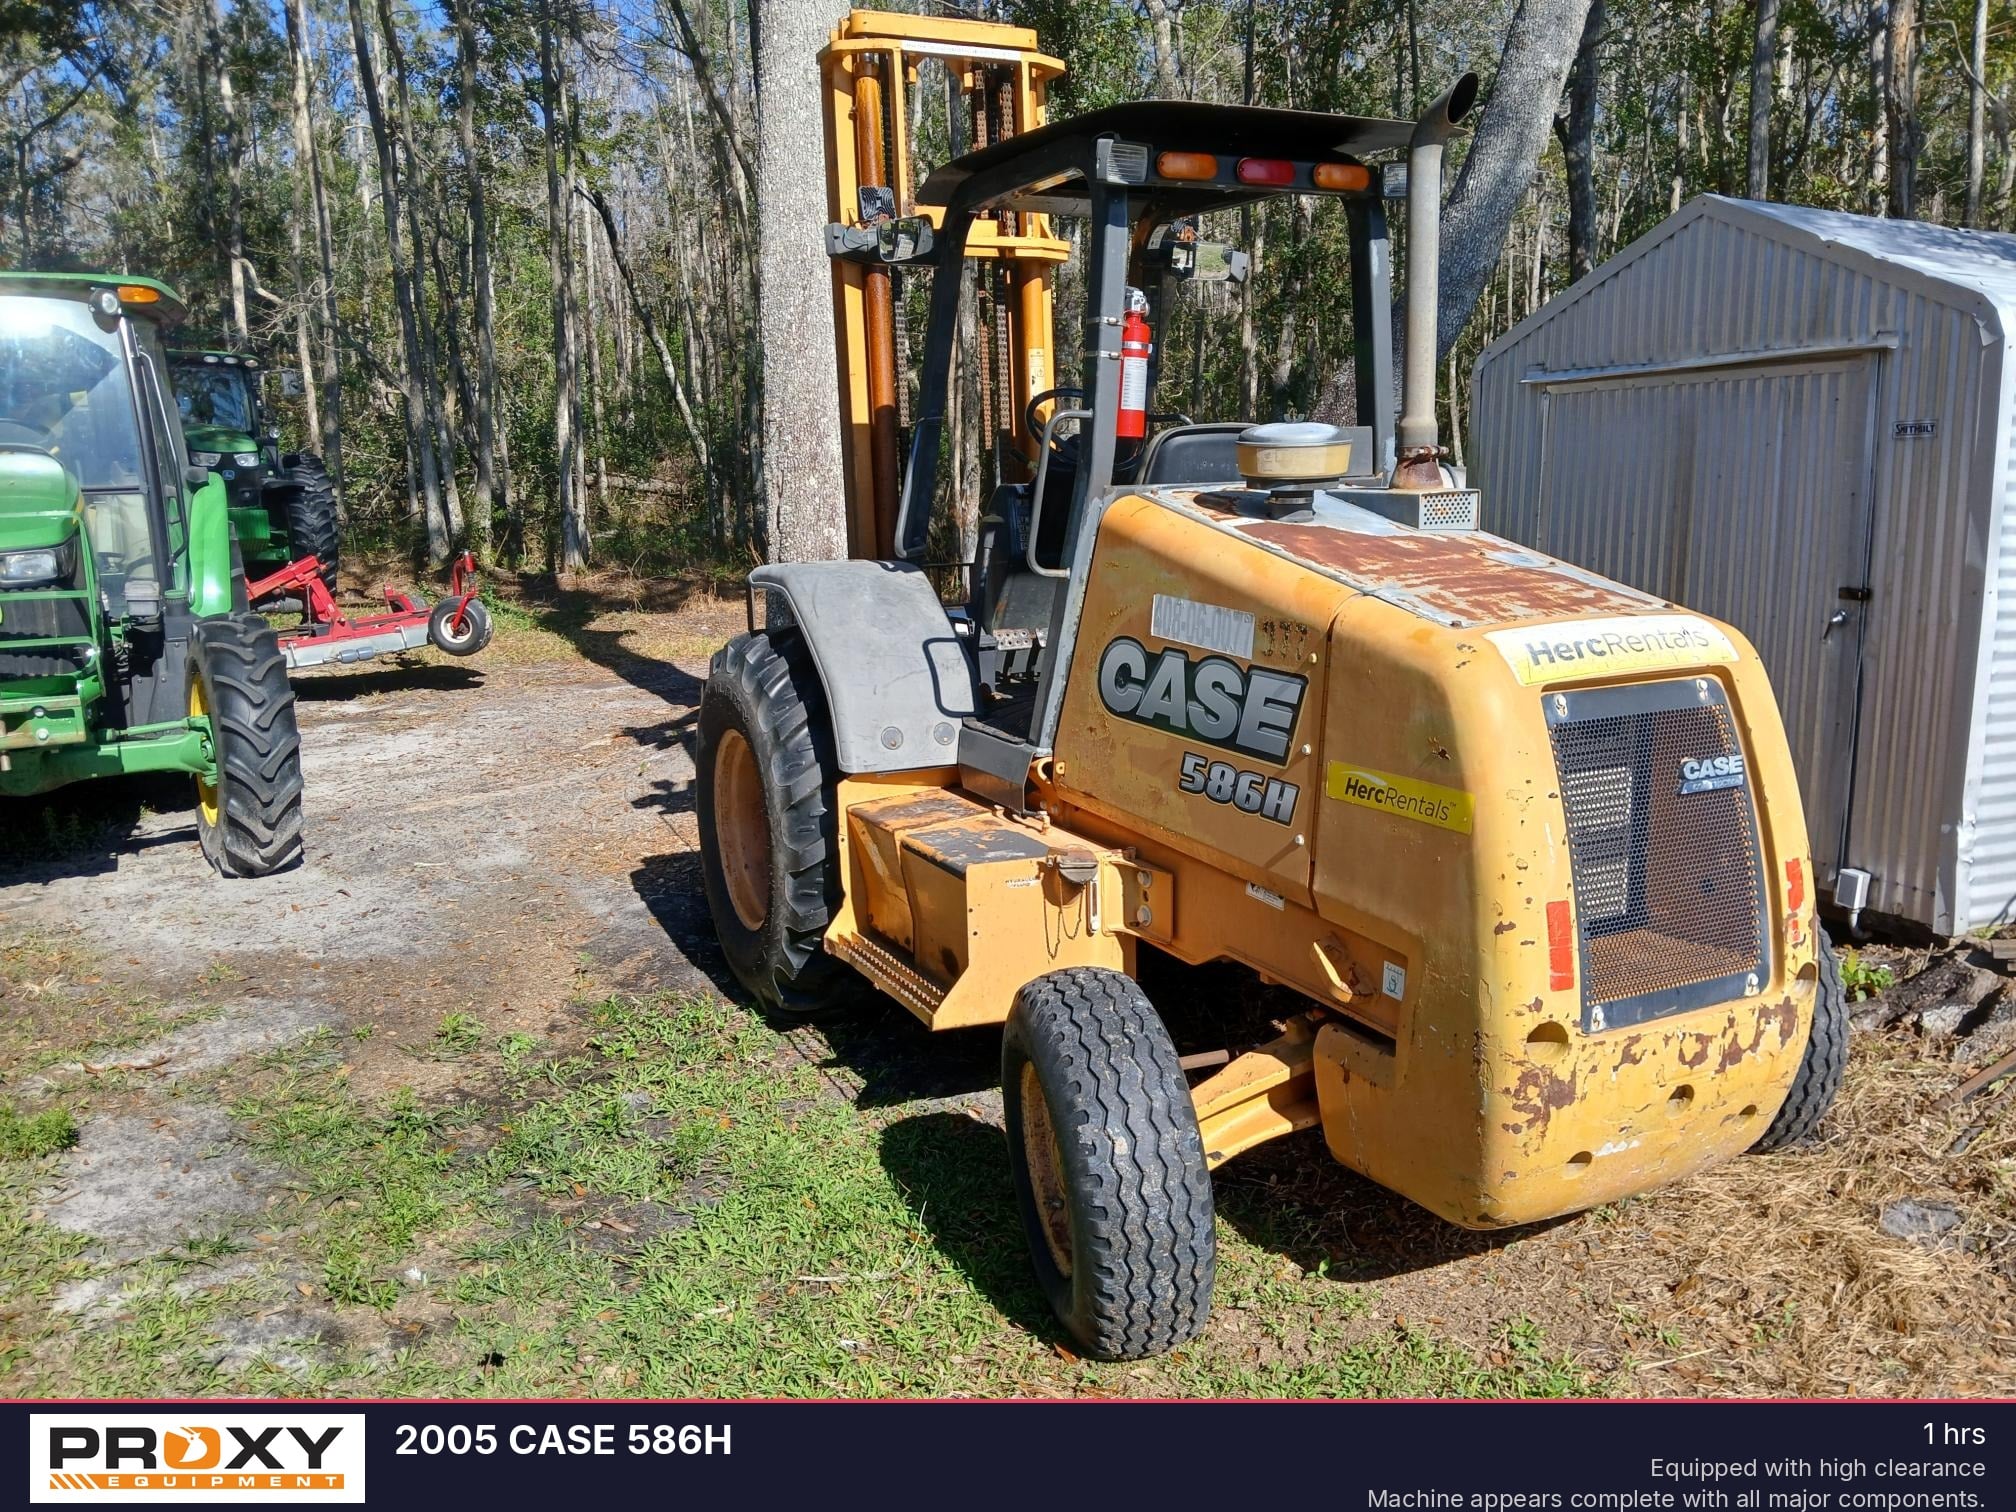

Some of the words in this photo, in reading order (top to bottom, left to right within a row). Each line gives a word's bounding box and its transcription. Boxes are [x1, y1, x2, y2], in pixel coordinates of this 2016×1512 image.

[1525, 626, 1709, 666] HercRentals
[1100, 641, 1303, 759] CASE
[1180, 752, 1299, 825] 586H
[1683, 755, 1743, 780] CASE
